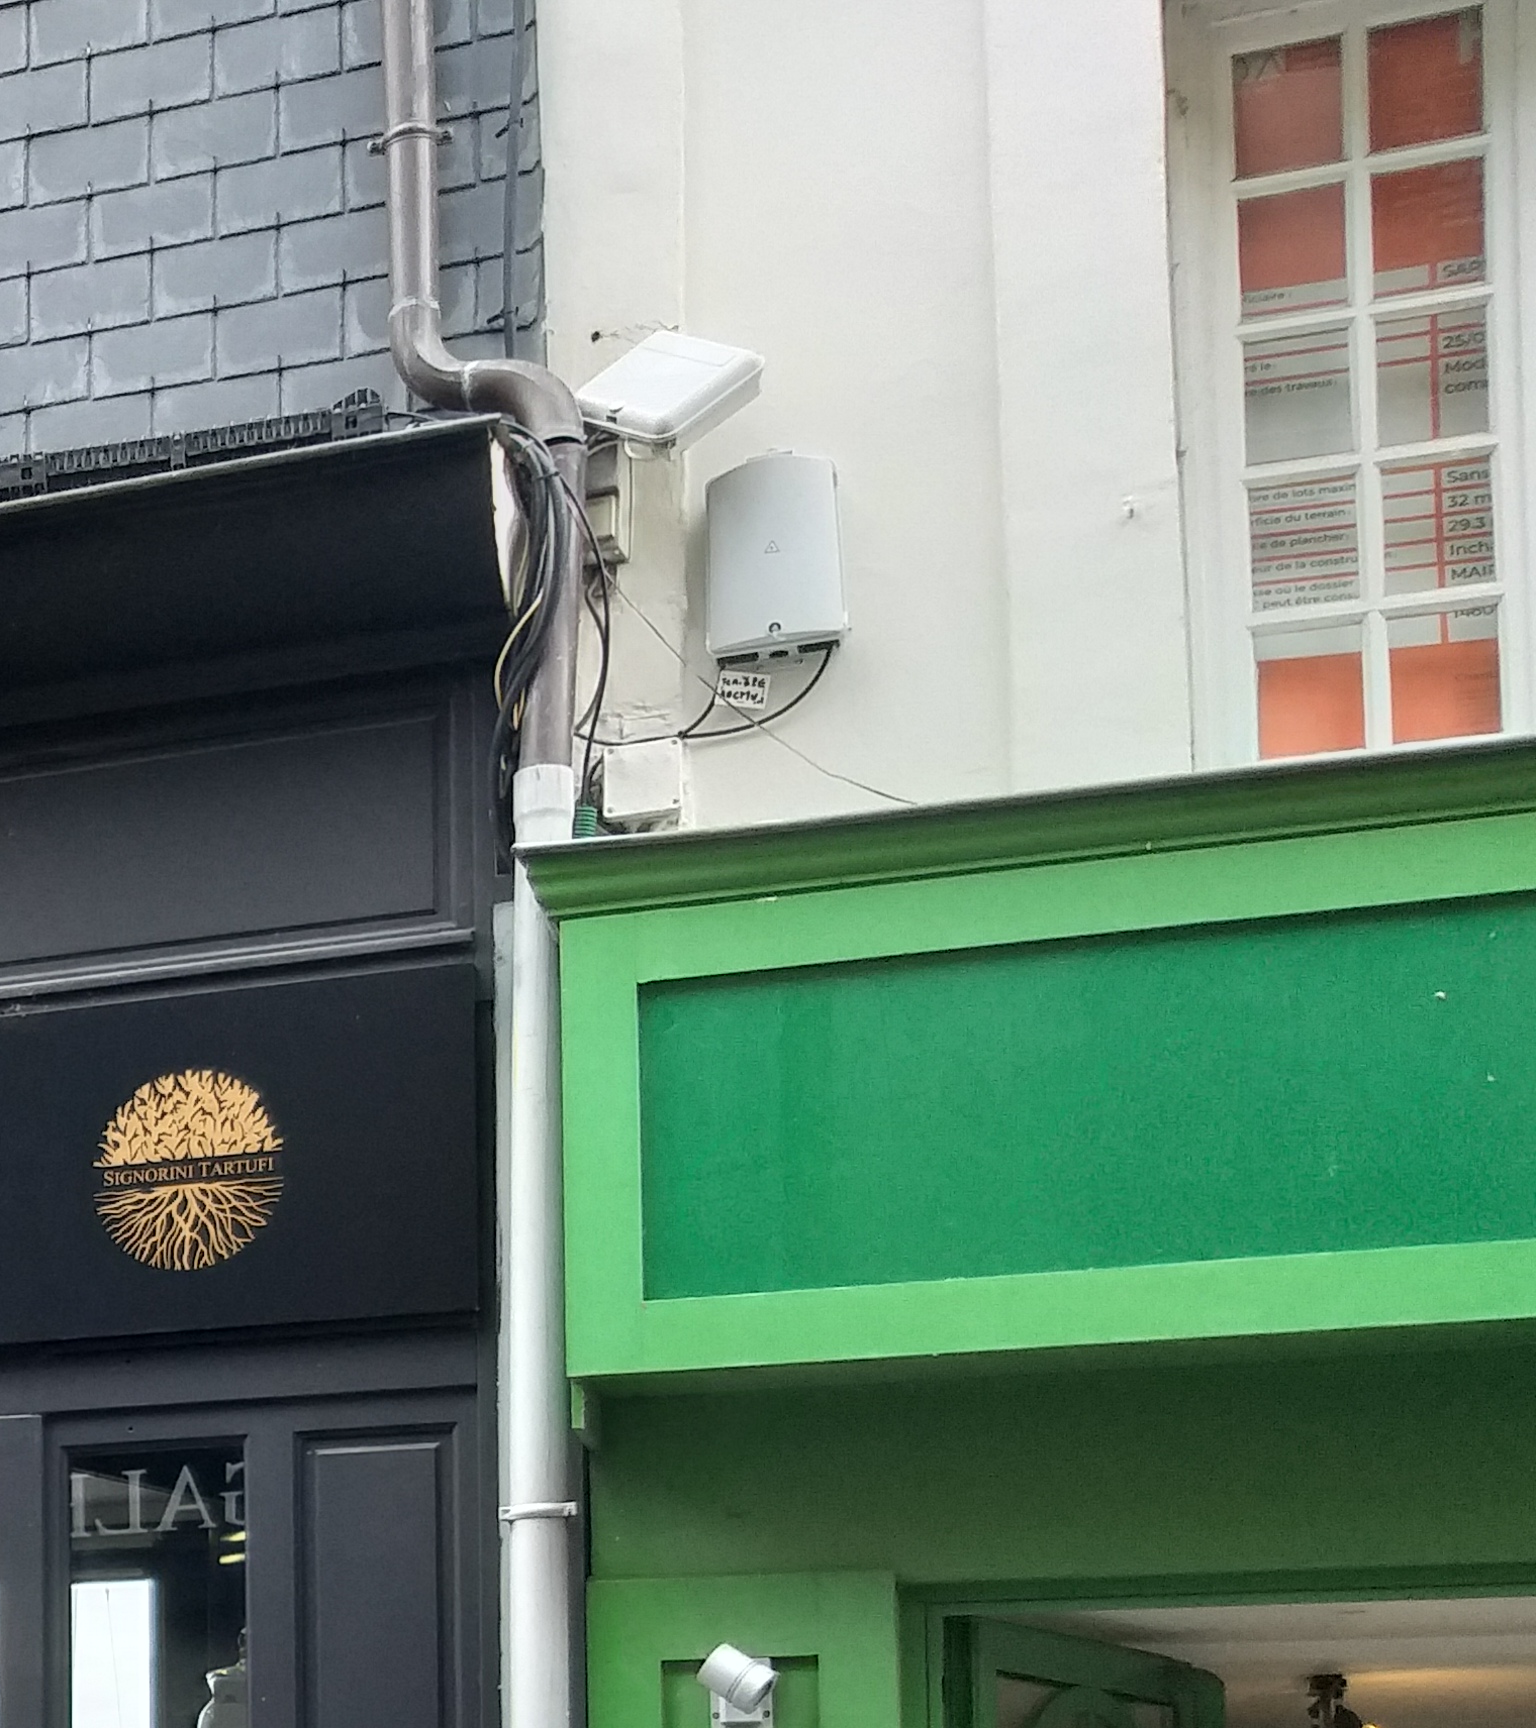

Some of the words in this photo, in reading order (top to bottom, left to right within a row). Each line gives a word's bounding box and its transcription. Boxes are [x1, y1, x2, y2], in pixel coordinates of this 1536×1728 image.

[1448, 493, 1470, 508] 32
[1449, 540, 1493, 556] Inch
[102, 1163, 195, 1187] SIGNORINI
[198, 1155, 275, 1178] TARTUFI
